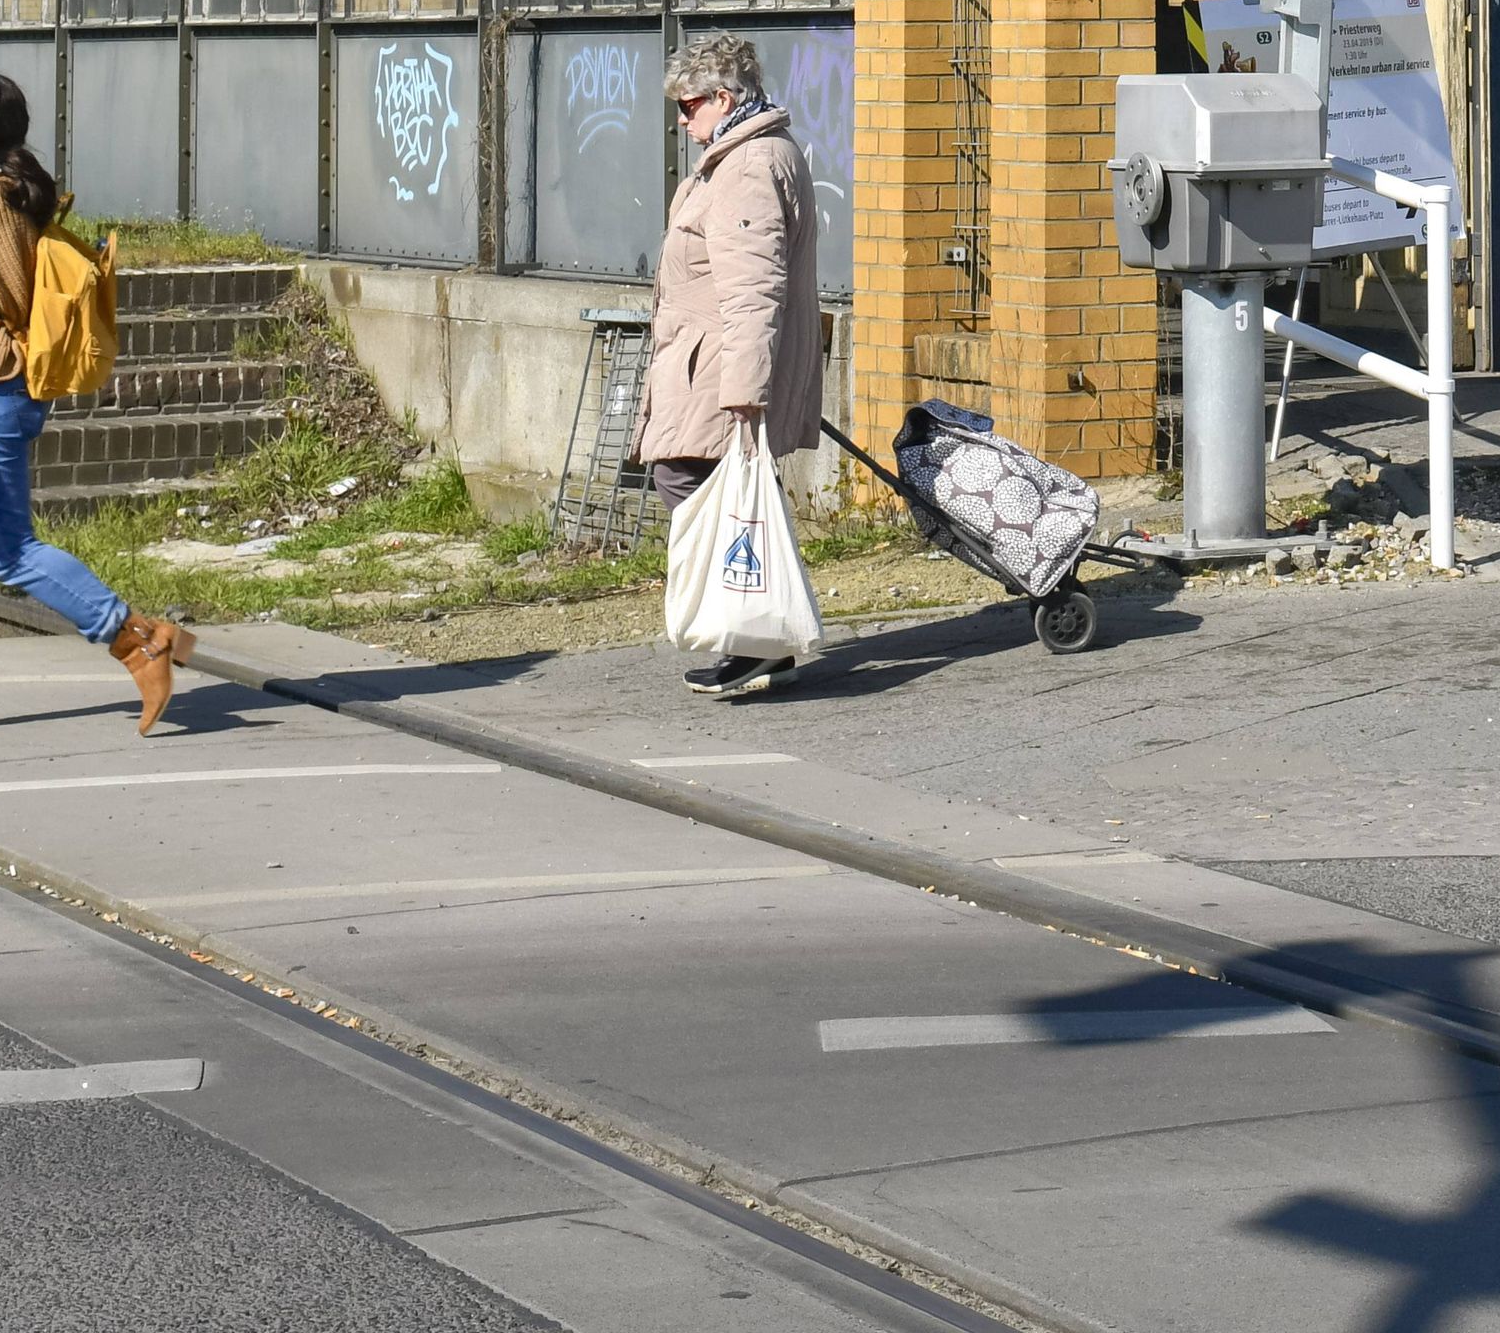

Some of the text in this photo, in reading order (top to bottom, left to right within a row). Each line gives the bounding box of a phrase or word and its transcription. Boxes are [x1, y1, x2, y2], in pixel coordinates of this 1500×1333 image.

[1339, 24, 1382, 35] Priesterweg
[1258, 32, 1271, 44] S2
[1372, 62, 1392, 73] urban
[1393, 60, 1405, 71] rail
[1406, 59, 1430, 70] service
[1344, 107, 1366, 119] service
[1367, 107, 1374, 118] by
[1363, 156, 1378, 166] buses
[1380, 153, 1398, 164] depart
[1399, 153, 1405, 161] to
[1325, 199, 1369, 212] buses depart to
[1235, 301, 1248, 331] 5
